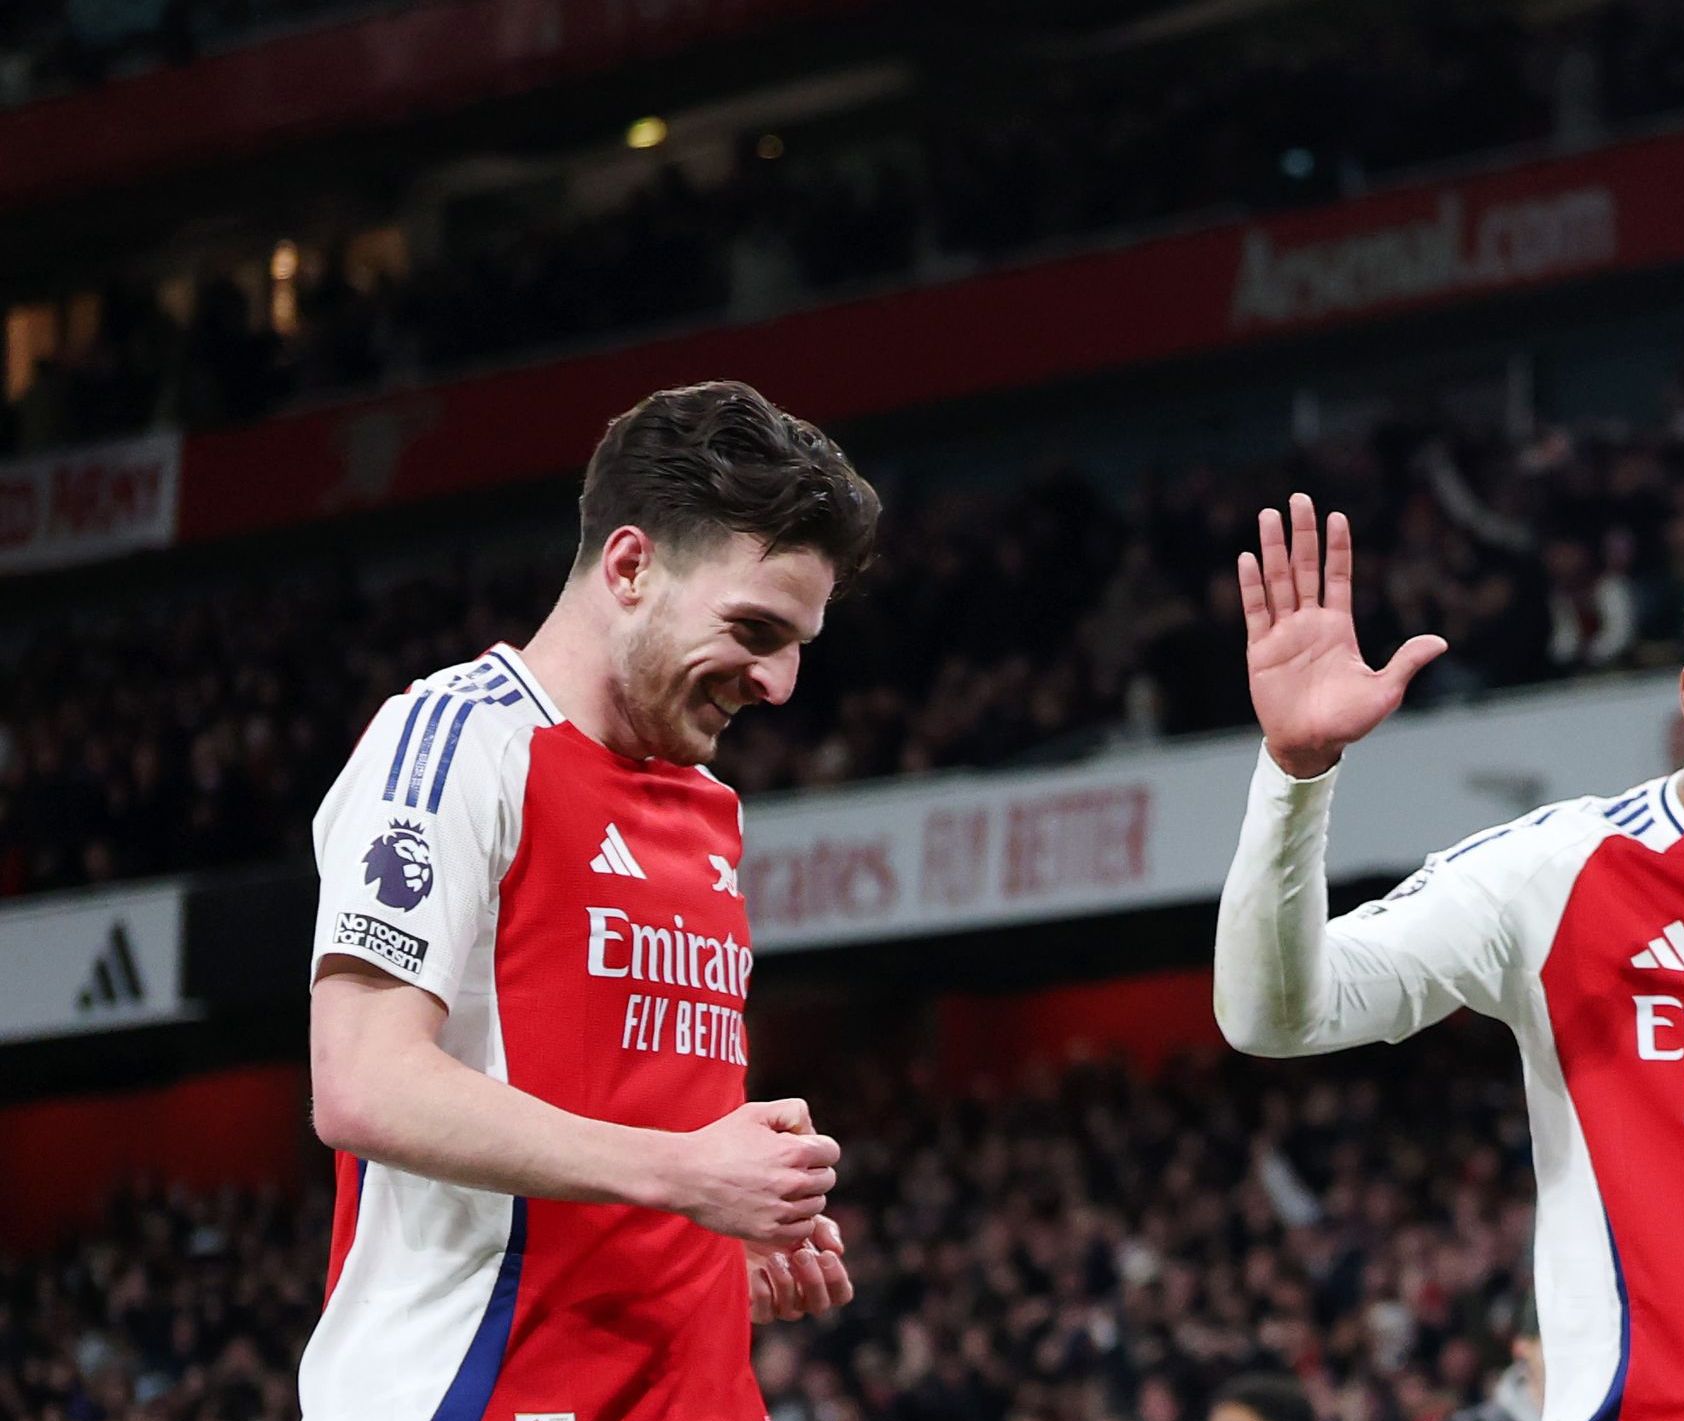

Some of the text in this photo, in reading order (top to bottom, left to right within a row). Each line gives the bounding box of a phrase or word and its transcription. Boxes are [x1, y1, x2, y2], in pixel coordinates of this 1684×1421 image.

[745, 833, 897, 928] rates
[333, 927, 423, 975] for racism
[337, 913, 419, 956] No room
[585, 907, 753, 999] Emirate
[621, 994, 669, 1052] FLY
